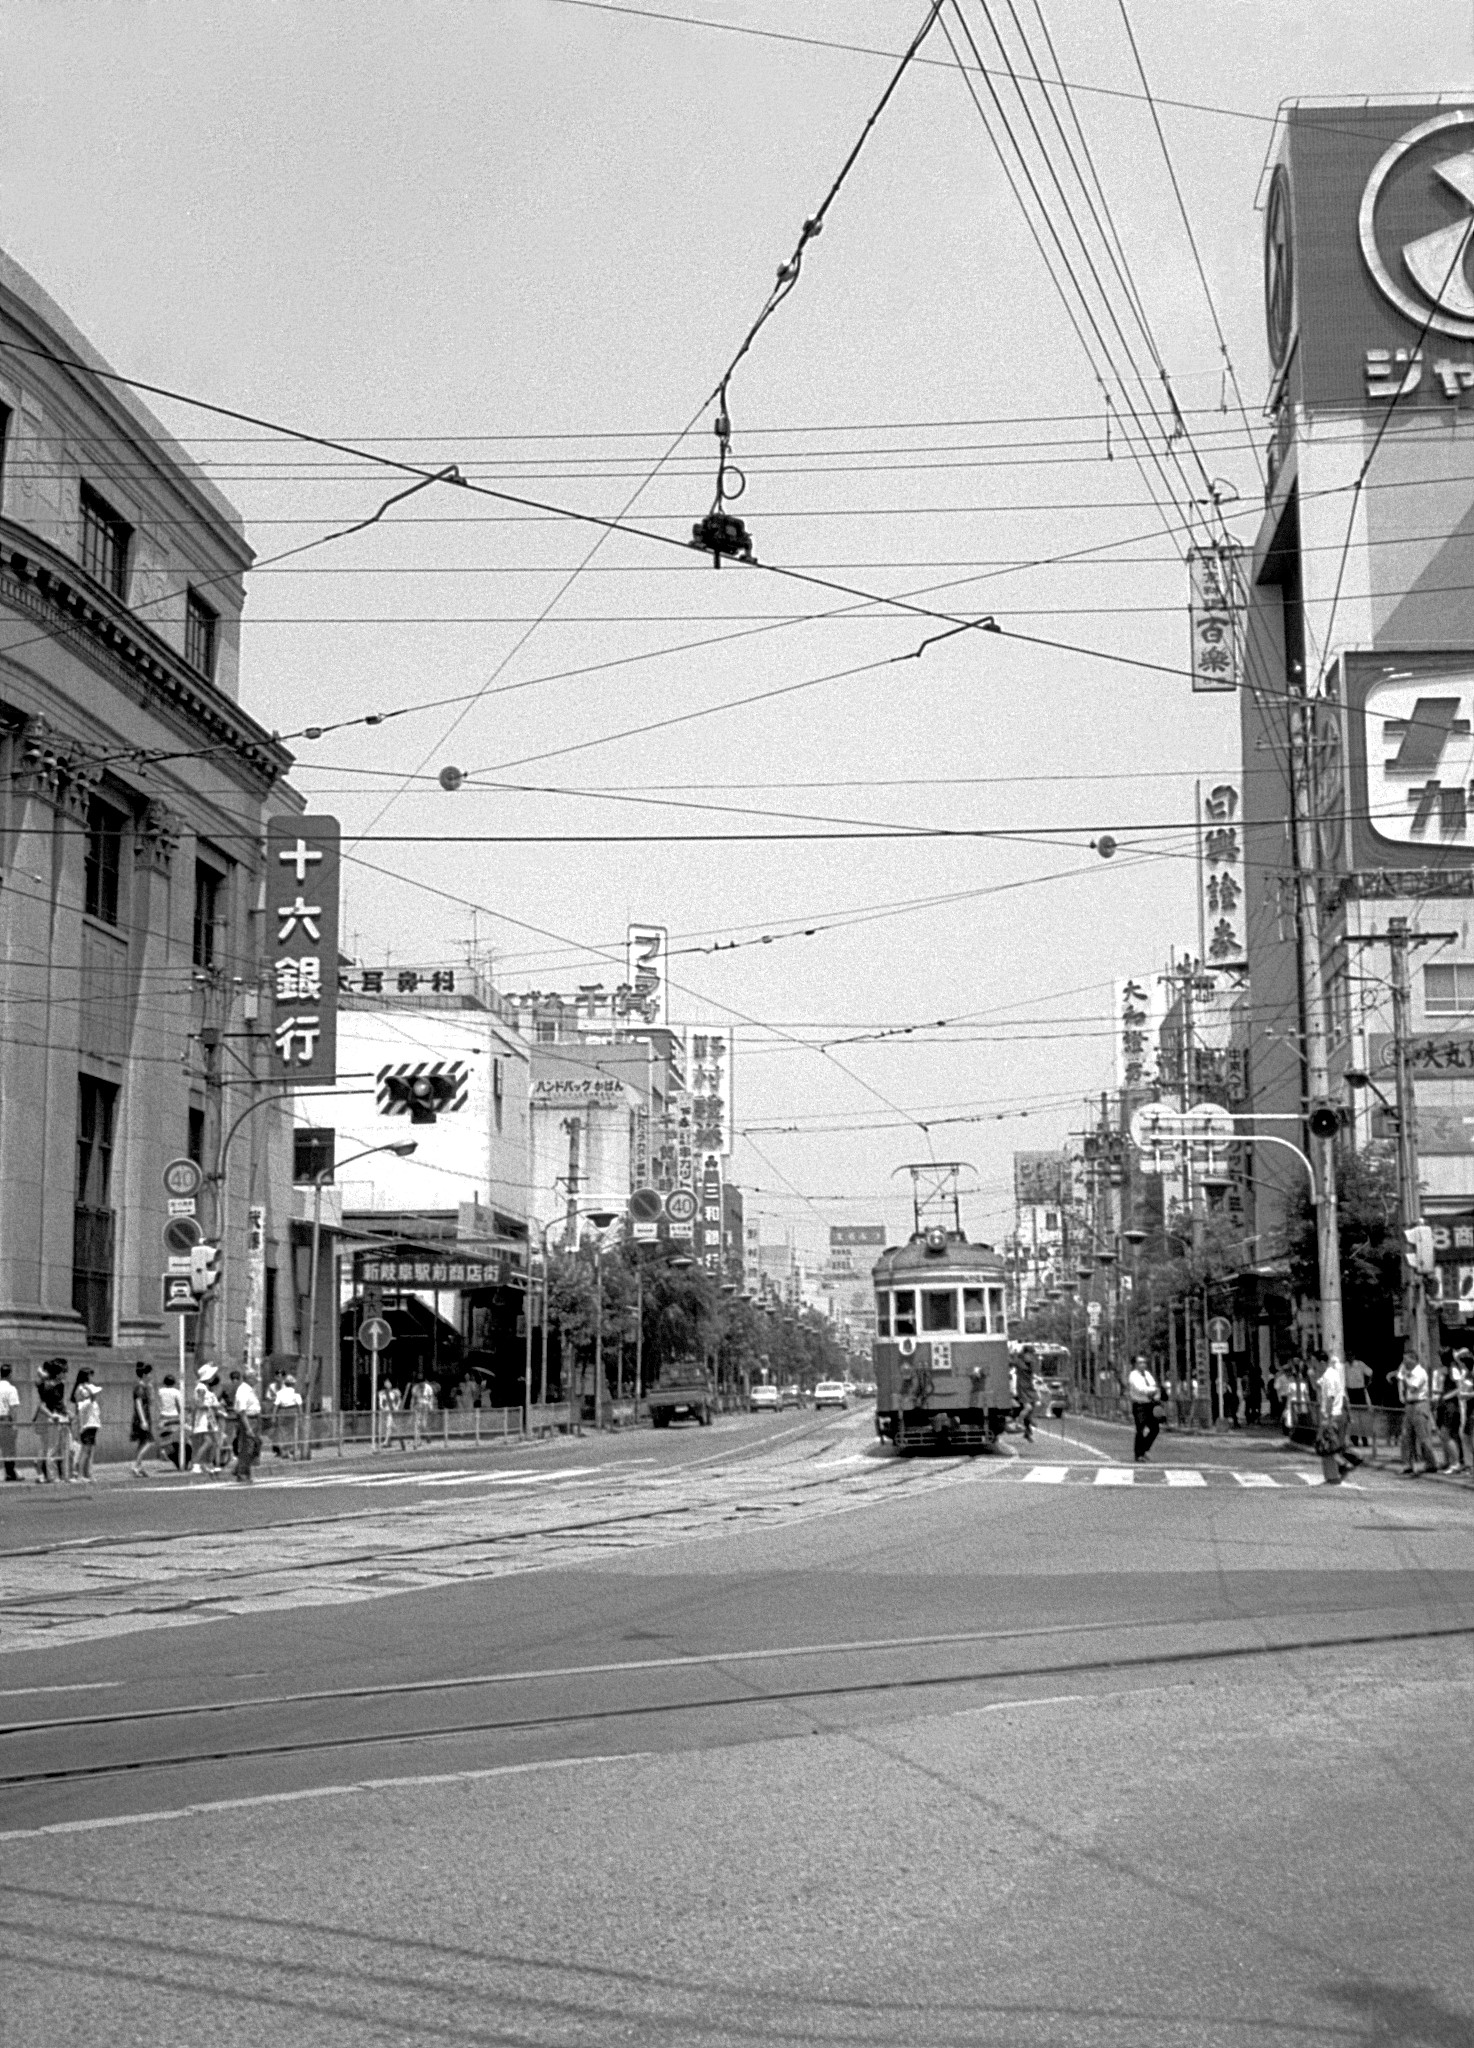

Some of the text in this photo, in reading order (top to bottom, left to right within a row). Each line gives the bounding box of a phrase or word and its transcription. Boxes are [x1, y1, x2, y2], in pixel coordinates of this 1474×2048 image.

[274, 838, 323, 1060] 十六銀行
[172, 1170, 194, 1188] 40
[671, 1197, 693, 1215] 40
[363, 1262, 500, 1283] 新岐阜駅前商店街
